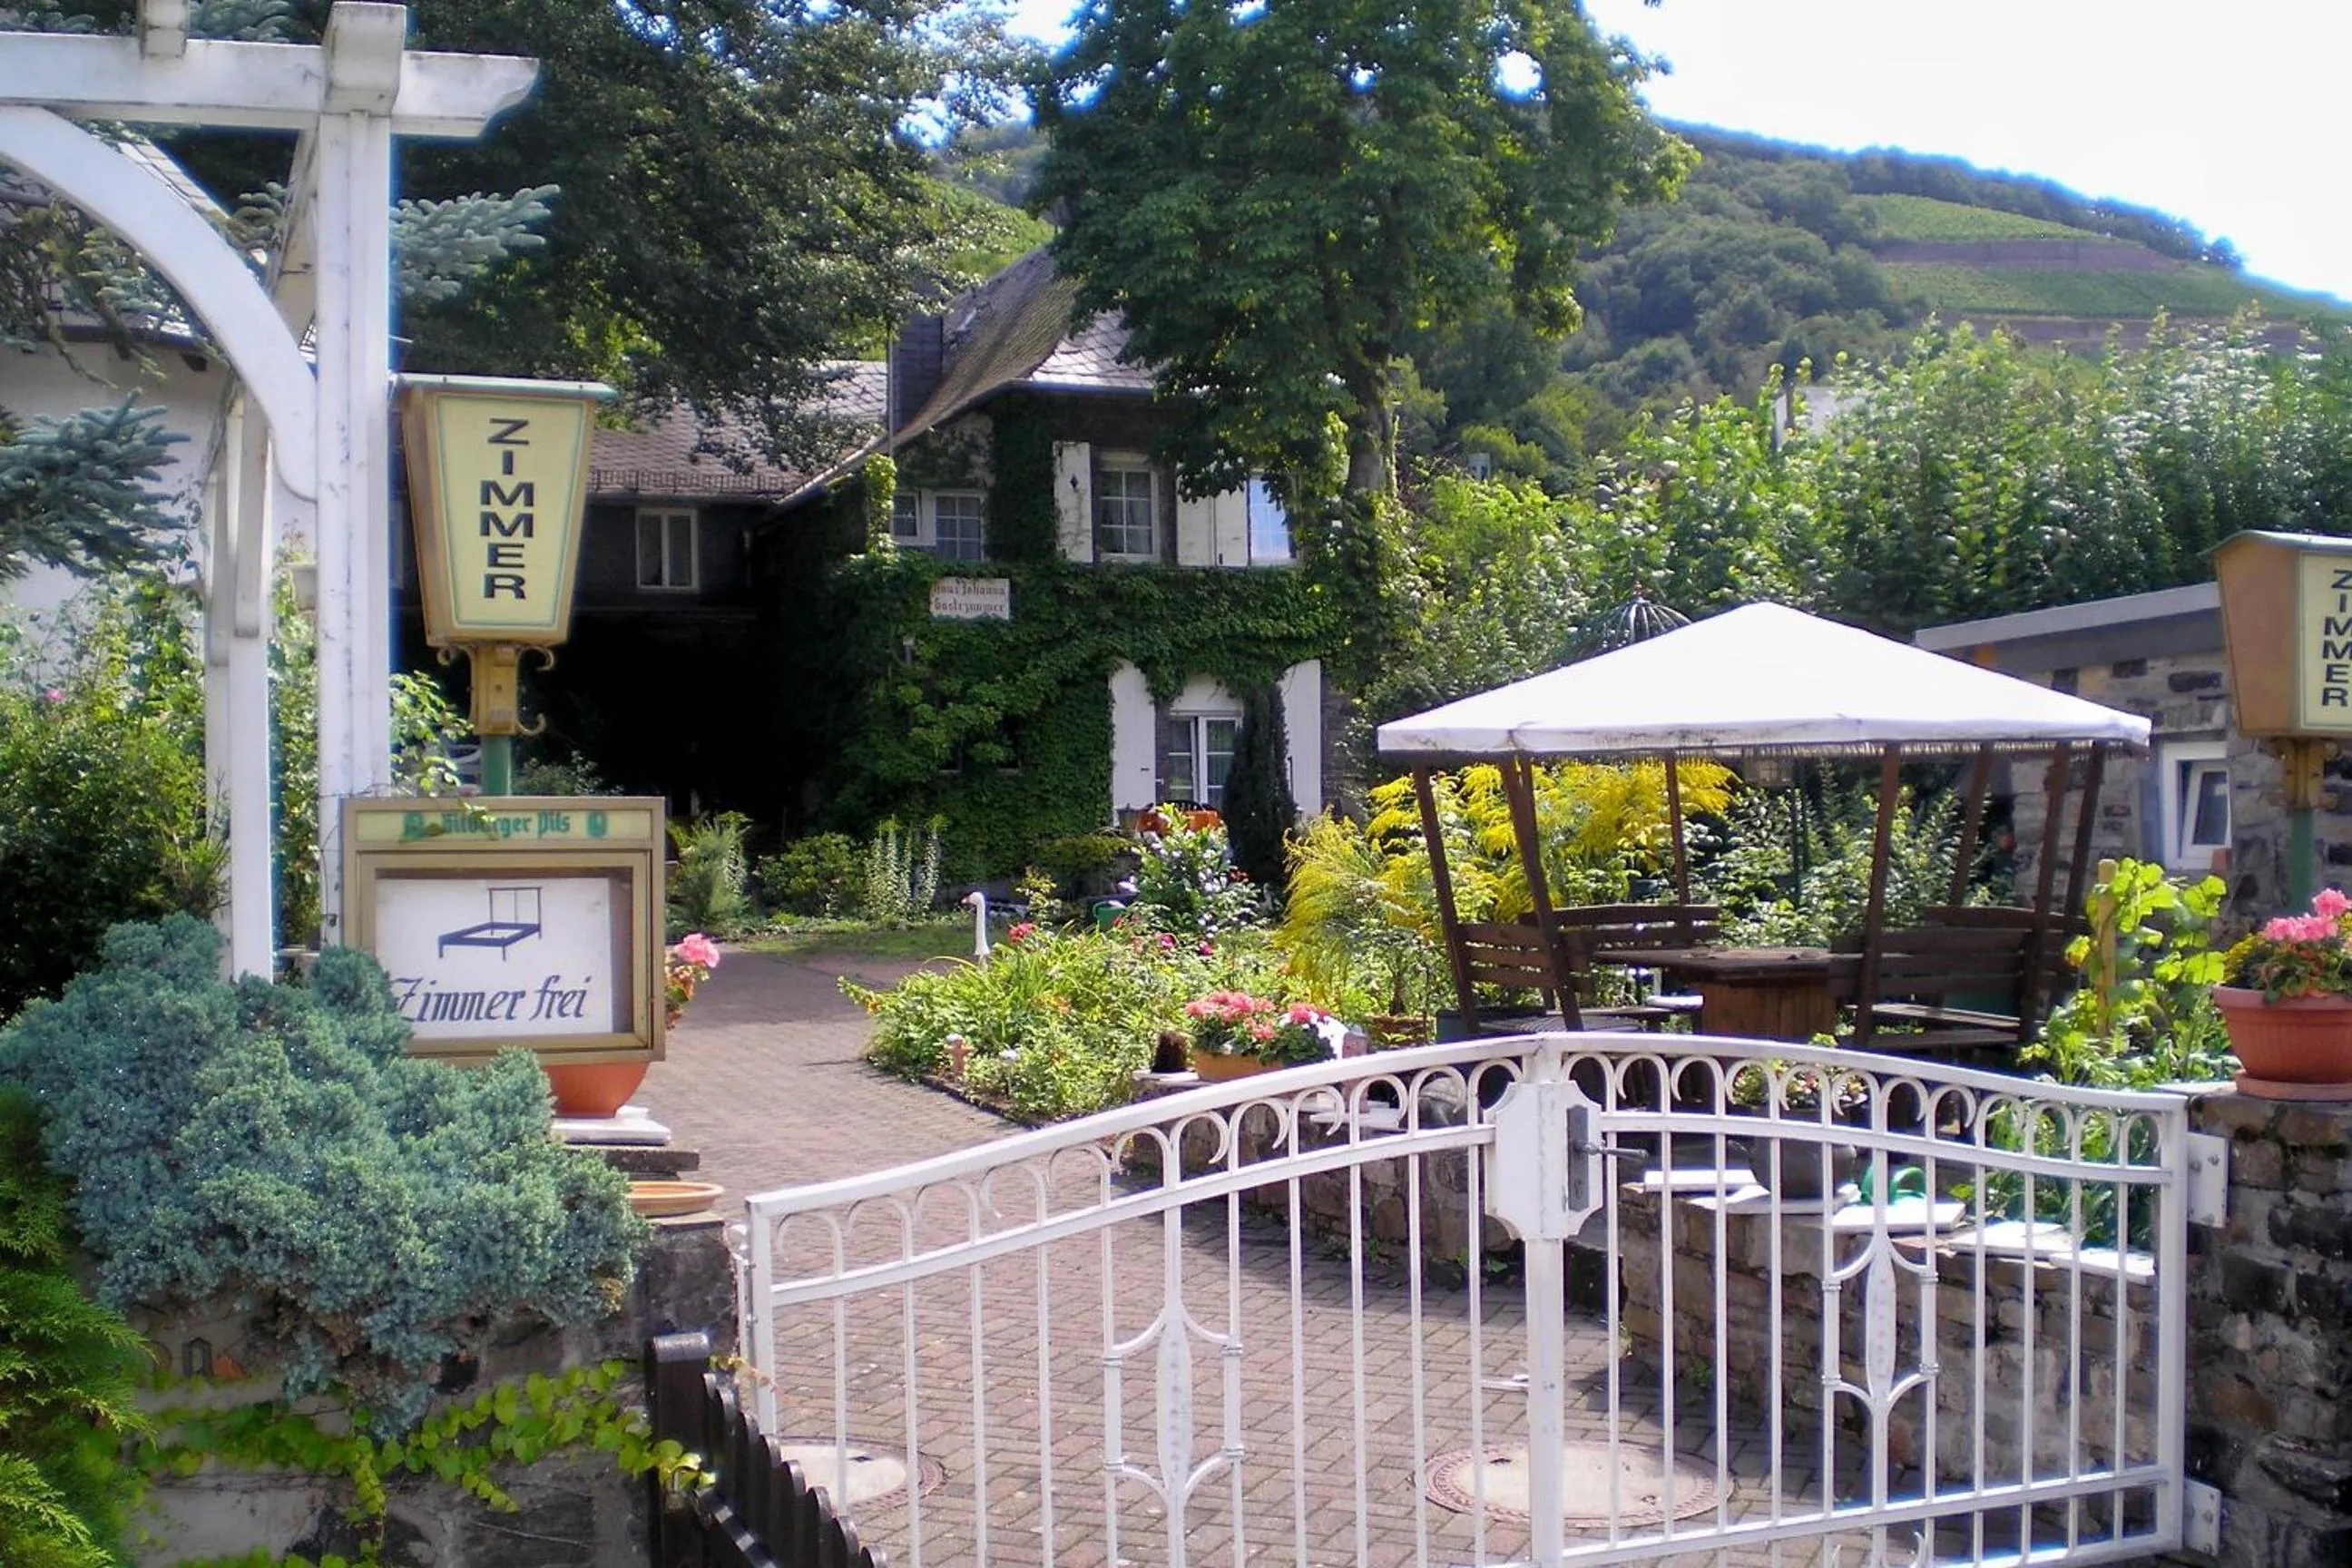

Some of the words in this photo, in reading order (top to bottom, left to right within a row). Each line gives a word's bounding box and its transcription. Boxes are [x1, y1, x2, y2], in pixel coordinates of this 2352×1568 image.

[480, 417, 534, 600] ZIMMER
[391, 977, 526, 1024] Zimmer
[528, 975, 593, 1022] frei
